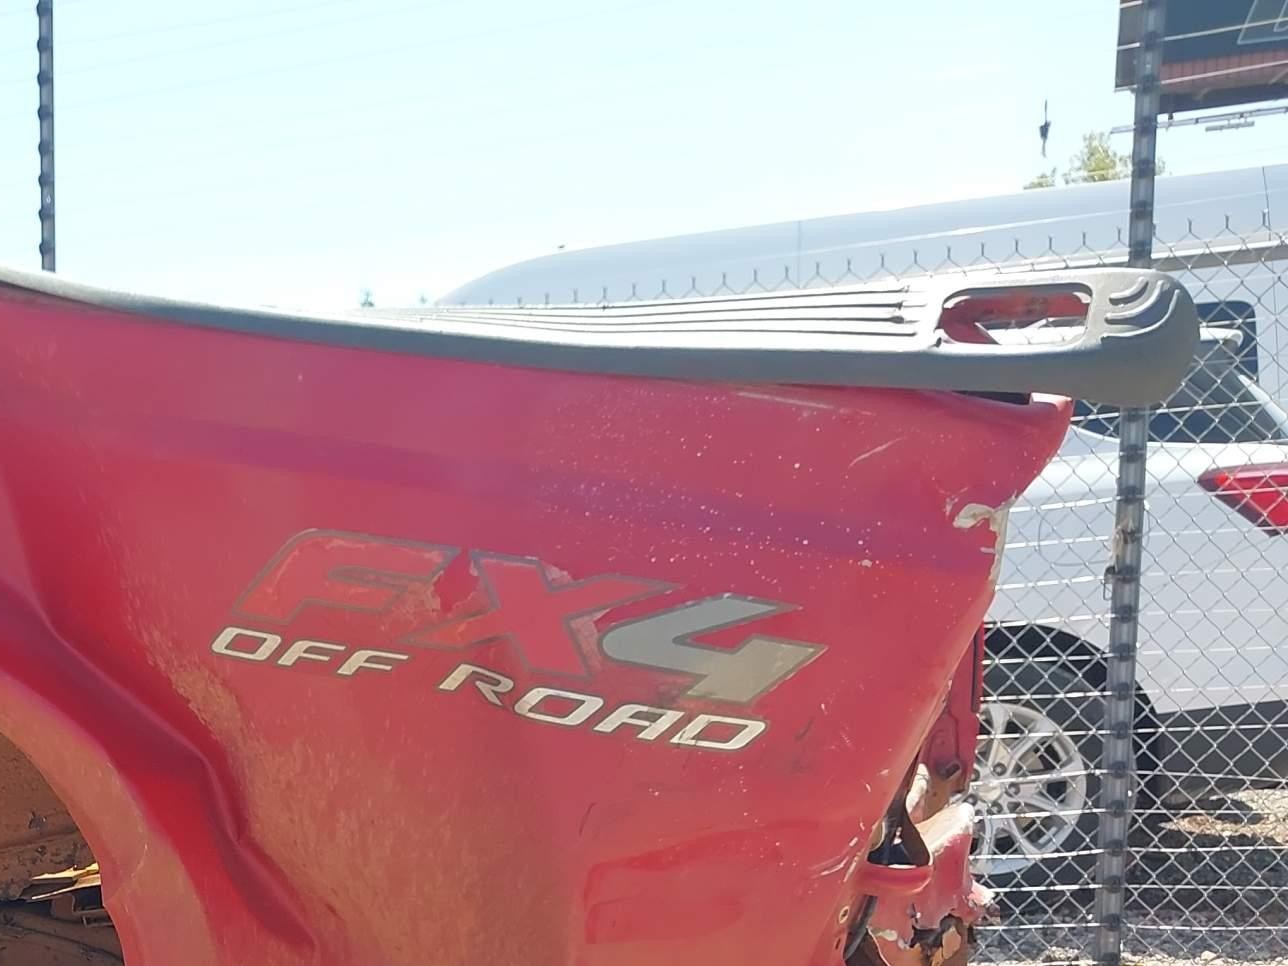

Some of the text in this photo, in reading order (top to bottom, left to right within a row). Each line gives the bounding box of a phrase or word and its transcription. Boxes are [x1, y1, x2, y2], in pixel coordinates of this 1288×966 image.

[211, 626, 767, 750] OFF ROAD
[231, 528, 829, 703] FX4
